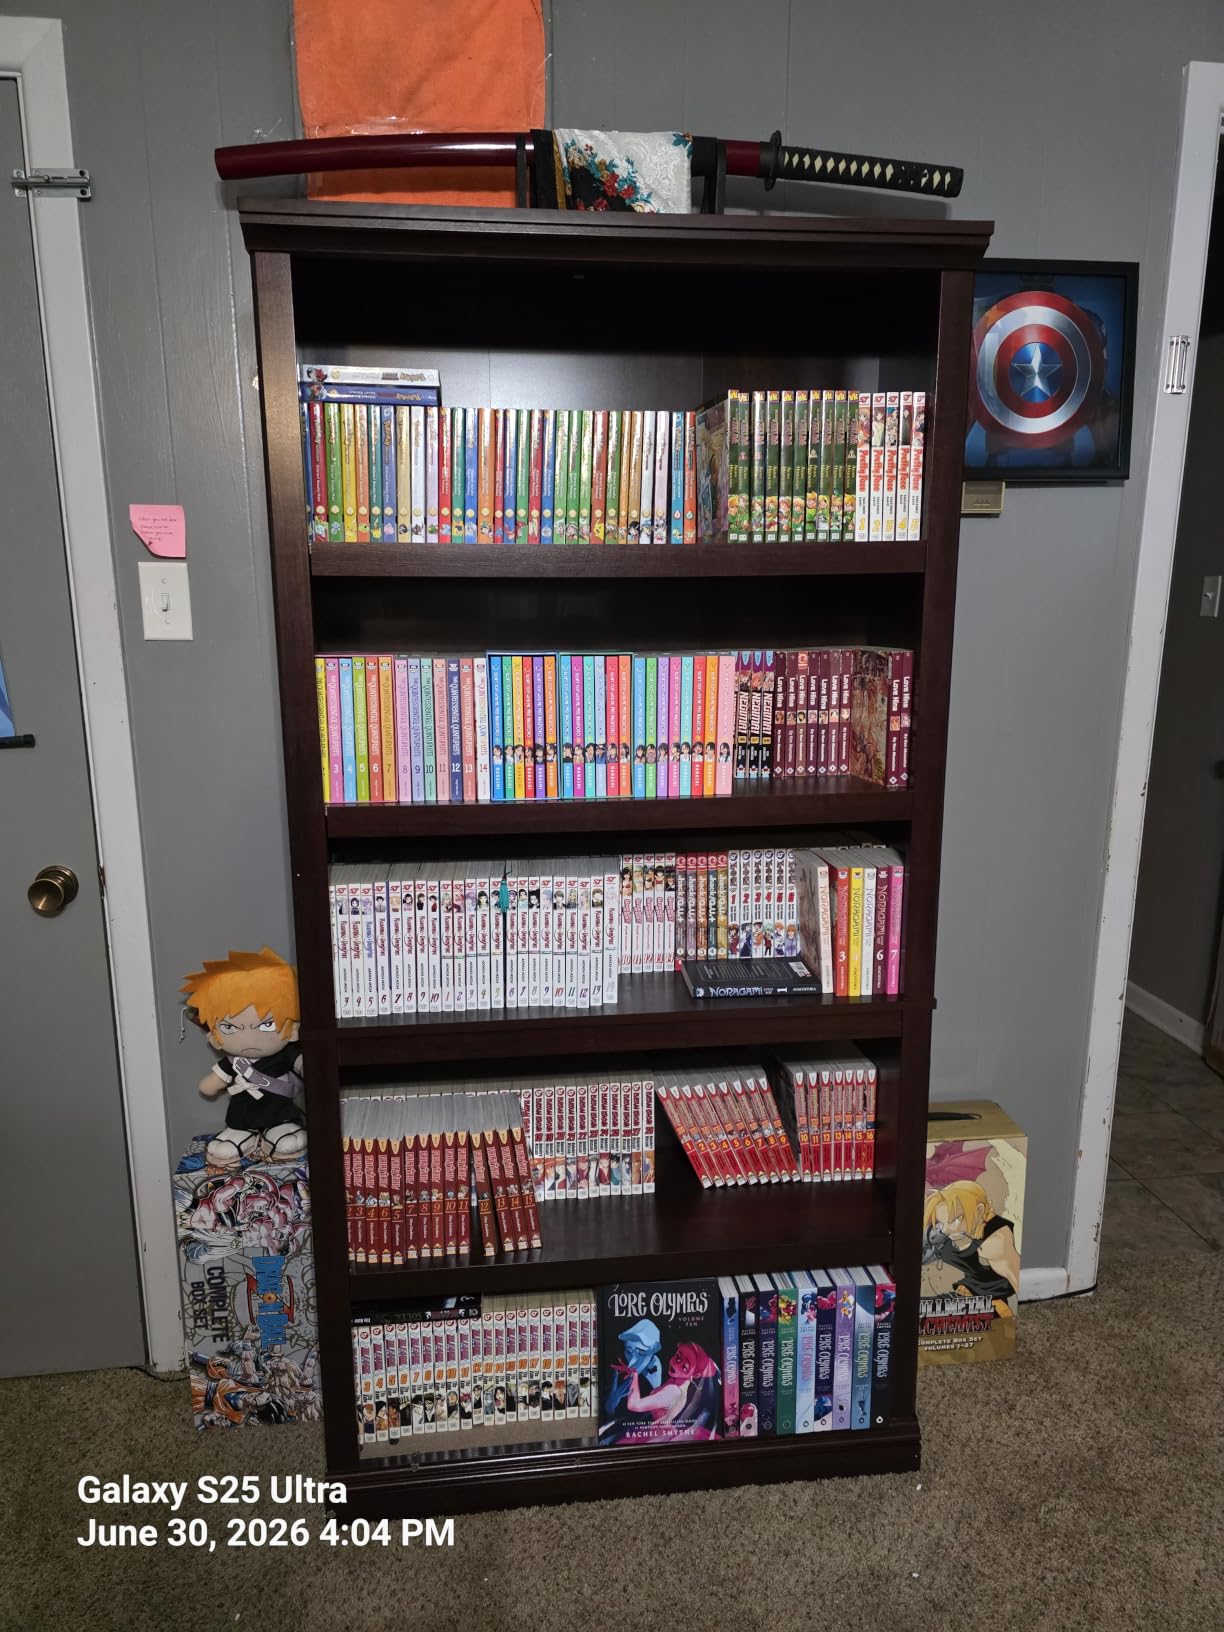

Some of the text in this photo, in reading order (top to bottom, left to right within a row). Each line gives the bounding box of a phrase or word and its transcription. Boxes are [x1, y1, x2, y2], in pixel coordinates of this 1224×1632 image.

[858, 450, 868, 492] Pretty Face
[872, 449, 882, 492] Pretty Face
[886, 449, 896, 492] Pretty Face
[899, 448, 910, 490] Pretty Face
[912, 449, 922, 491] Pretty Face
[859, 518, 866, 530] 1
[872, 520, 880, 532] 2
[898, 518, 906, 530] 4
[911, 519, 919, 531] 5
[892, 680, 900, 695] Love
[902, 676, 910, 708] Love Hina
[333, 764, 339, 774] 3
[373, 763, 379, 773] 6
[387, 764, 391, 773] 7
[403, 765, 407, 774] 8
[415, 765, 420, 774] 9
[426, 764, 433, 774] 10
[439, 764, 445, 773] 11
[452, 763, 460, 773] 12
[465, 763, 472, 773] 13
[480, 763, 487, 773] 14
[732, 894, 736, 904] 1
[743, 893, 749, 904] 2
[765, 892, 772, 902] 4
[820, 886, 829, 936] NORAGAMI
[838, 886, 848, 936] NORAGAMI
[852, 887, 862, 937] NORAGAMI
[865, 888, 874, 937] NORAGAMI
[876, 885, 888, 935] NORAGAMI
[839, 951, 846, 962] 3
[876, 949, 884, 961] 6
[890, 950, 898, 960] 7
[710, 986, 763, 997] NORAGAMI
[734, 1140, 740, 1148] 5
[745, 1139, 751, 1147] 6
[812, 1135, 819, 1144] 11
[699, 1142, 705, 1150] 2
[356, 1207, 363, 1216] 3
[382, 1207, 388, 1216] 6
[408, 1205, 414, 1214] 7
[421, 1203, 428, 1212] 8
[445, 1202, 455, 1211] 10
[191, 1281, 208, 1330] BOX SET
[207, 1267, 230, 1343] COMPLETE
[252, 1256, 288, 1350] DRAGON BALL
[608, 1290, 708, 1321] LORE OLYMPUS
[919, 1295, 994, 1318] ULLMETAL
[919, 1315, 994, 1335] LCHEMIST
[799, 1336, 814, 1382] LORE OLYMPUS
[818, 1333, 832, 1379] LORE OLYMPUS
[836, 1334, 852, 1382] LORE OLYMPUS
[856, 1332, 871, 1378] LORE OLYMPUS
[874, 1331, 891, 1378] LORE OLYMPUS
[724, 1344, 737, 1384] LORE OLYMPUS
[741, 1340, 756, 1388] LORE OLYMPUS
[760, 1339, 775, 1387] LORE OLYMPUS
[778, 1338, 794, 1386] LORE OLYMPUS
[662, 1429, 695, 1437] SMYTHE
